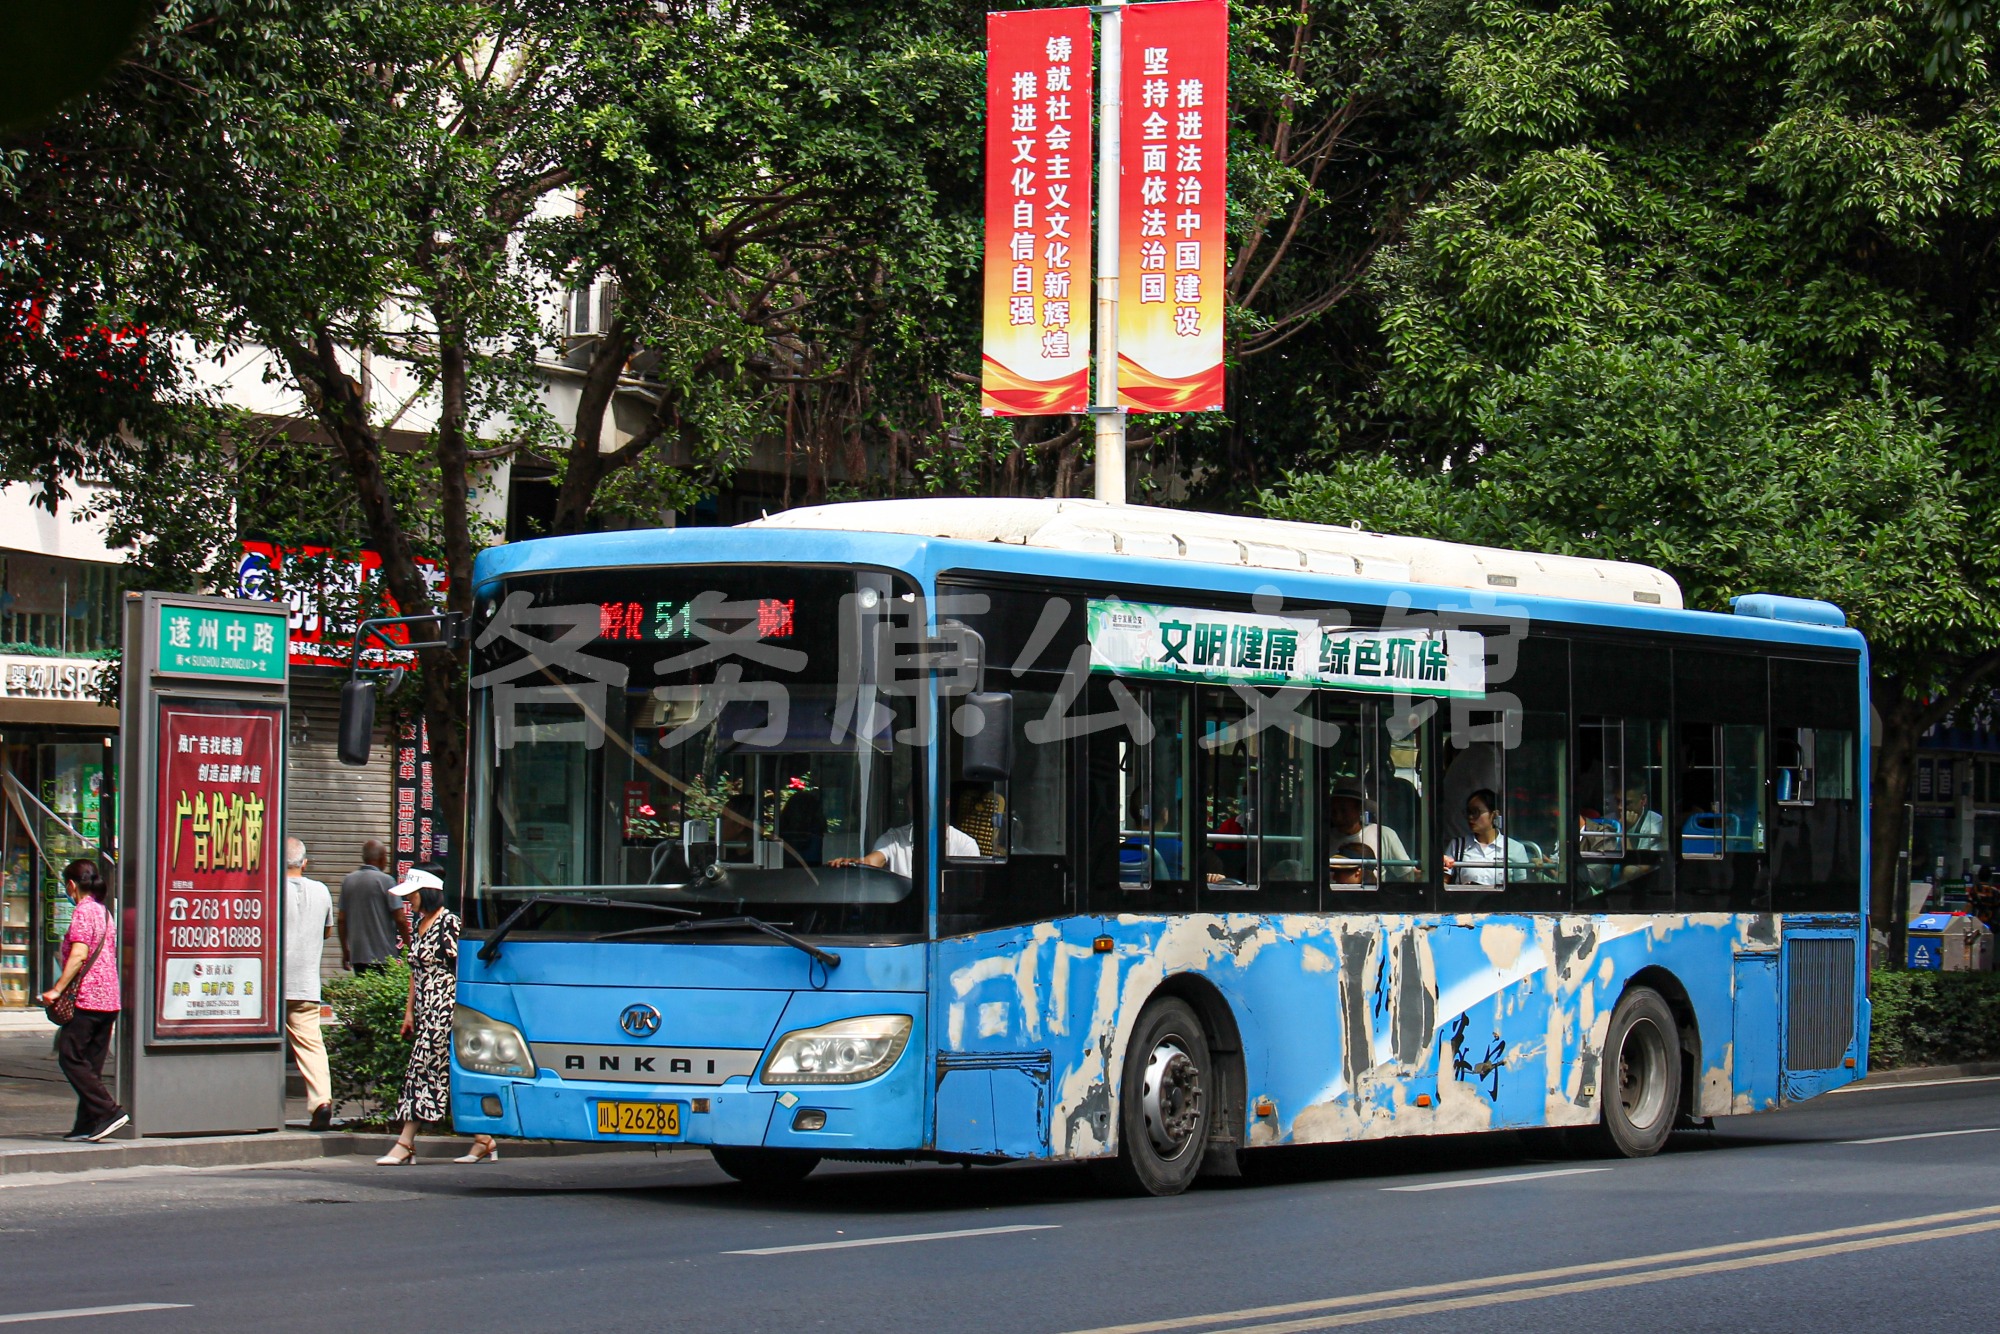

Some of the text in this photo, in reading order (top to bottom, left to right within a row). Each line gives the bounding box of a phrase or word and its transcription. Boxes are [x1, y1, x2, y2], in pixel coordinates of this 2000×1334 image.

[1009, 71, 1038, 327] 推进文化自信自强
[1041, 35, 1072, 359] 铸就社会主义文化新辉煌
[1140, 47, 1169, 304] 坚持全面依法治国
[1174, 79, 1204, 338] 推进法治中国建设
[168, 616, 275, 654] 遂州中路
[654, 601, 690, 640] 51
[1158, 619, 1448, 682] 文明健康 绿色环保
[172, 789, 265, 874] 广告位招商
[169, 926, 262, 948] 18090818888
[191, 898, 262, 920] 2681999
[565, 1054, 715, 1075] ANKAI
